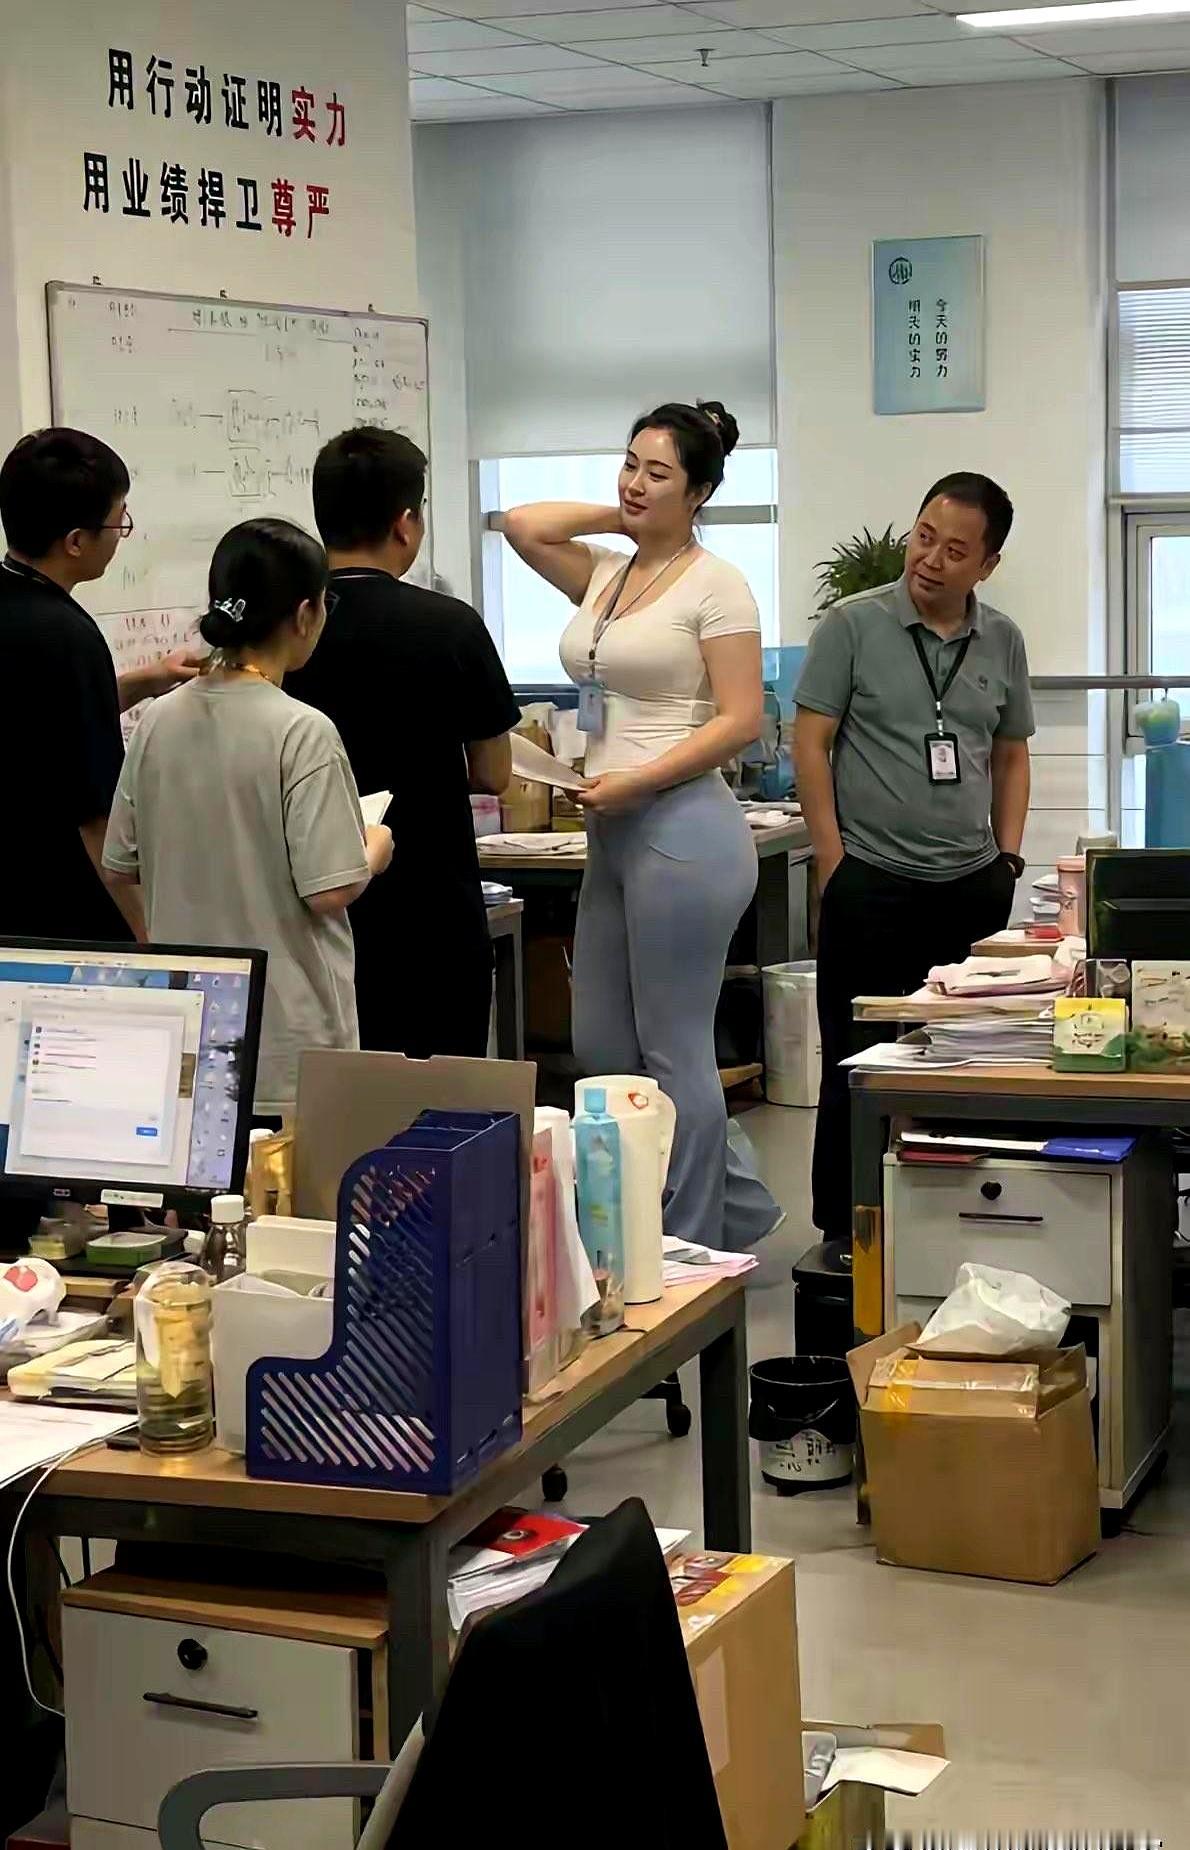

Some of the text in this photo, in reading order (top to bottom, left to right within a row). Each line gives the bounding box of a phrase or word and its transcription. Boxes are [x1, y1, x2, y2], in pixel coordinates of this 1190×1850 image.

[108, 48, 346, 147] 用行动证明实力
[83, 152, 331, 239] 用业绩捍卫尊严
